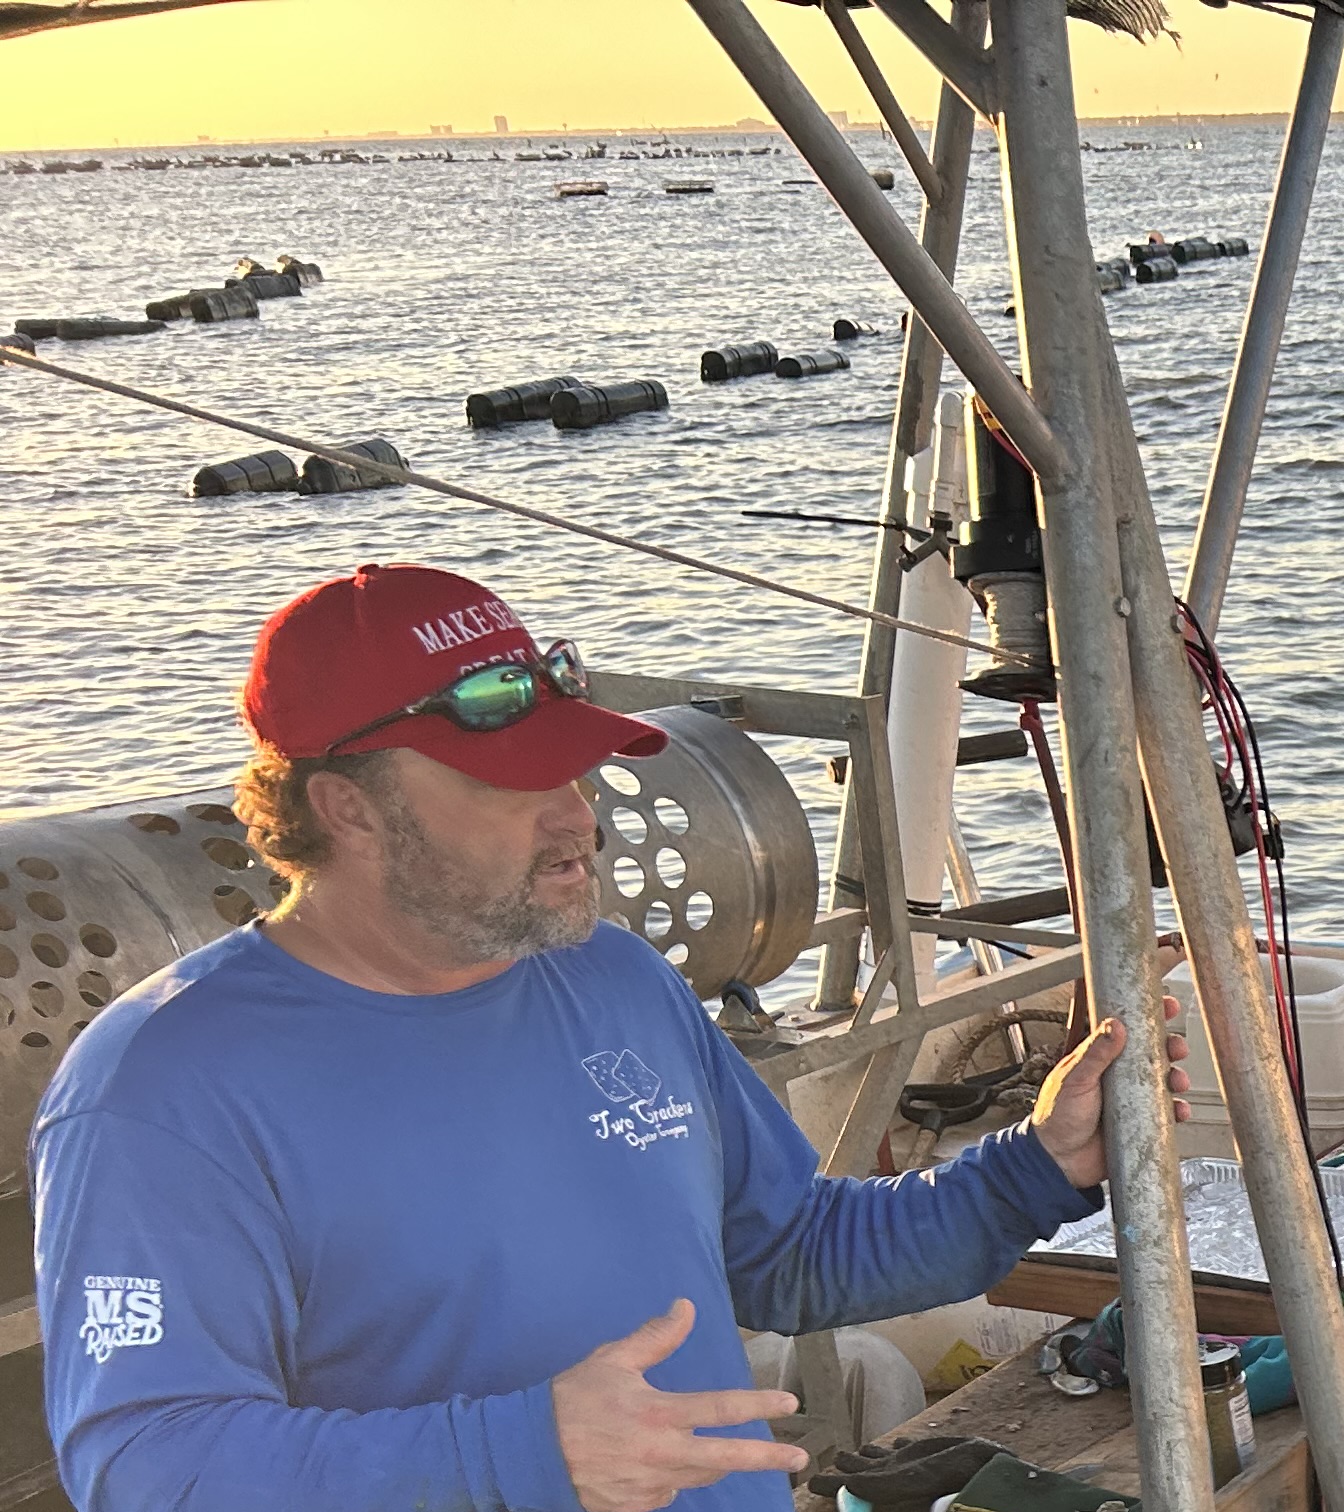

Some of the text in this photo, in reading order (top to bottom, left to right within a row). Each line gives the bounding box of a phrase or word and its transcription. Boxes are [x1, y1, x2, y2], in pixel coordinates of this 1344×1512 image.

[412, 605, 494, 654] MAKE
[588, 1095, 693, 1140] Two Crackers
[84, 1275, 162, 1291] GENUINE
[84, 1290, 163, 1325] MS
[80, 1322, 164, 1364] RAISED
